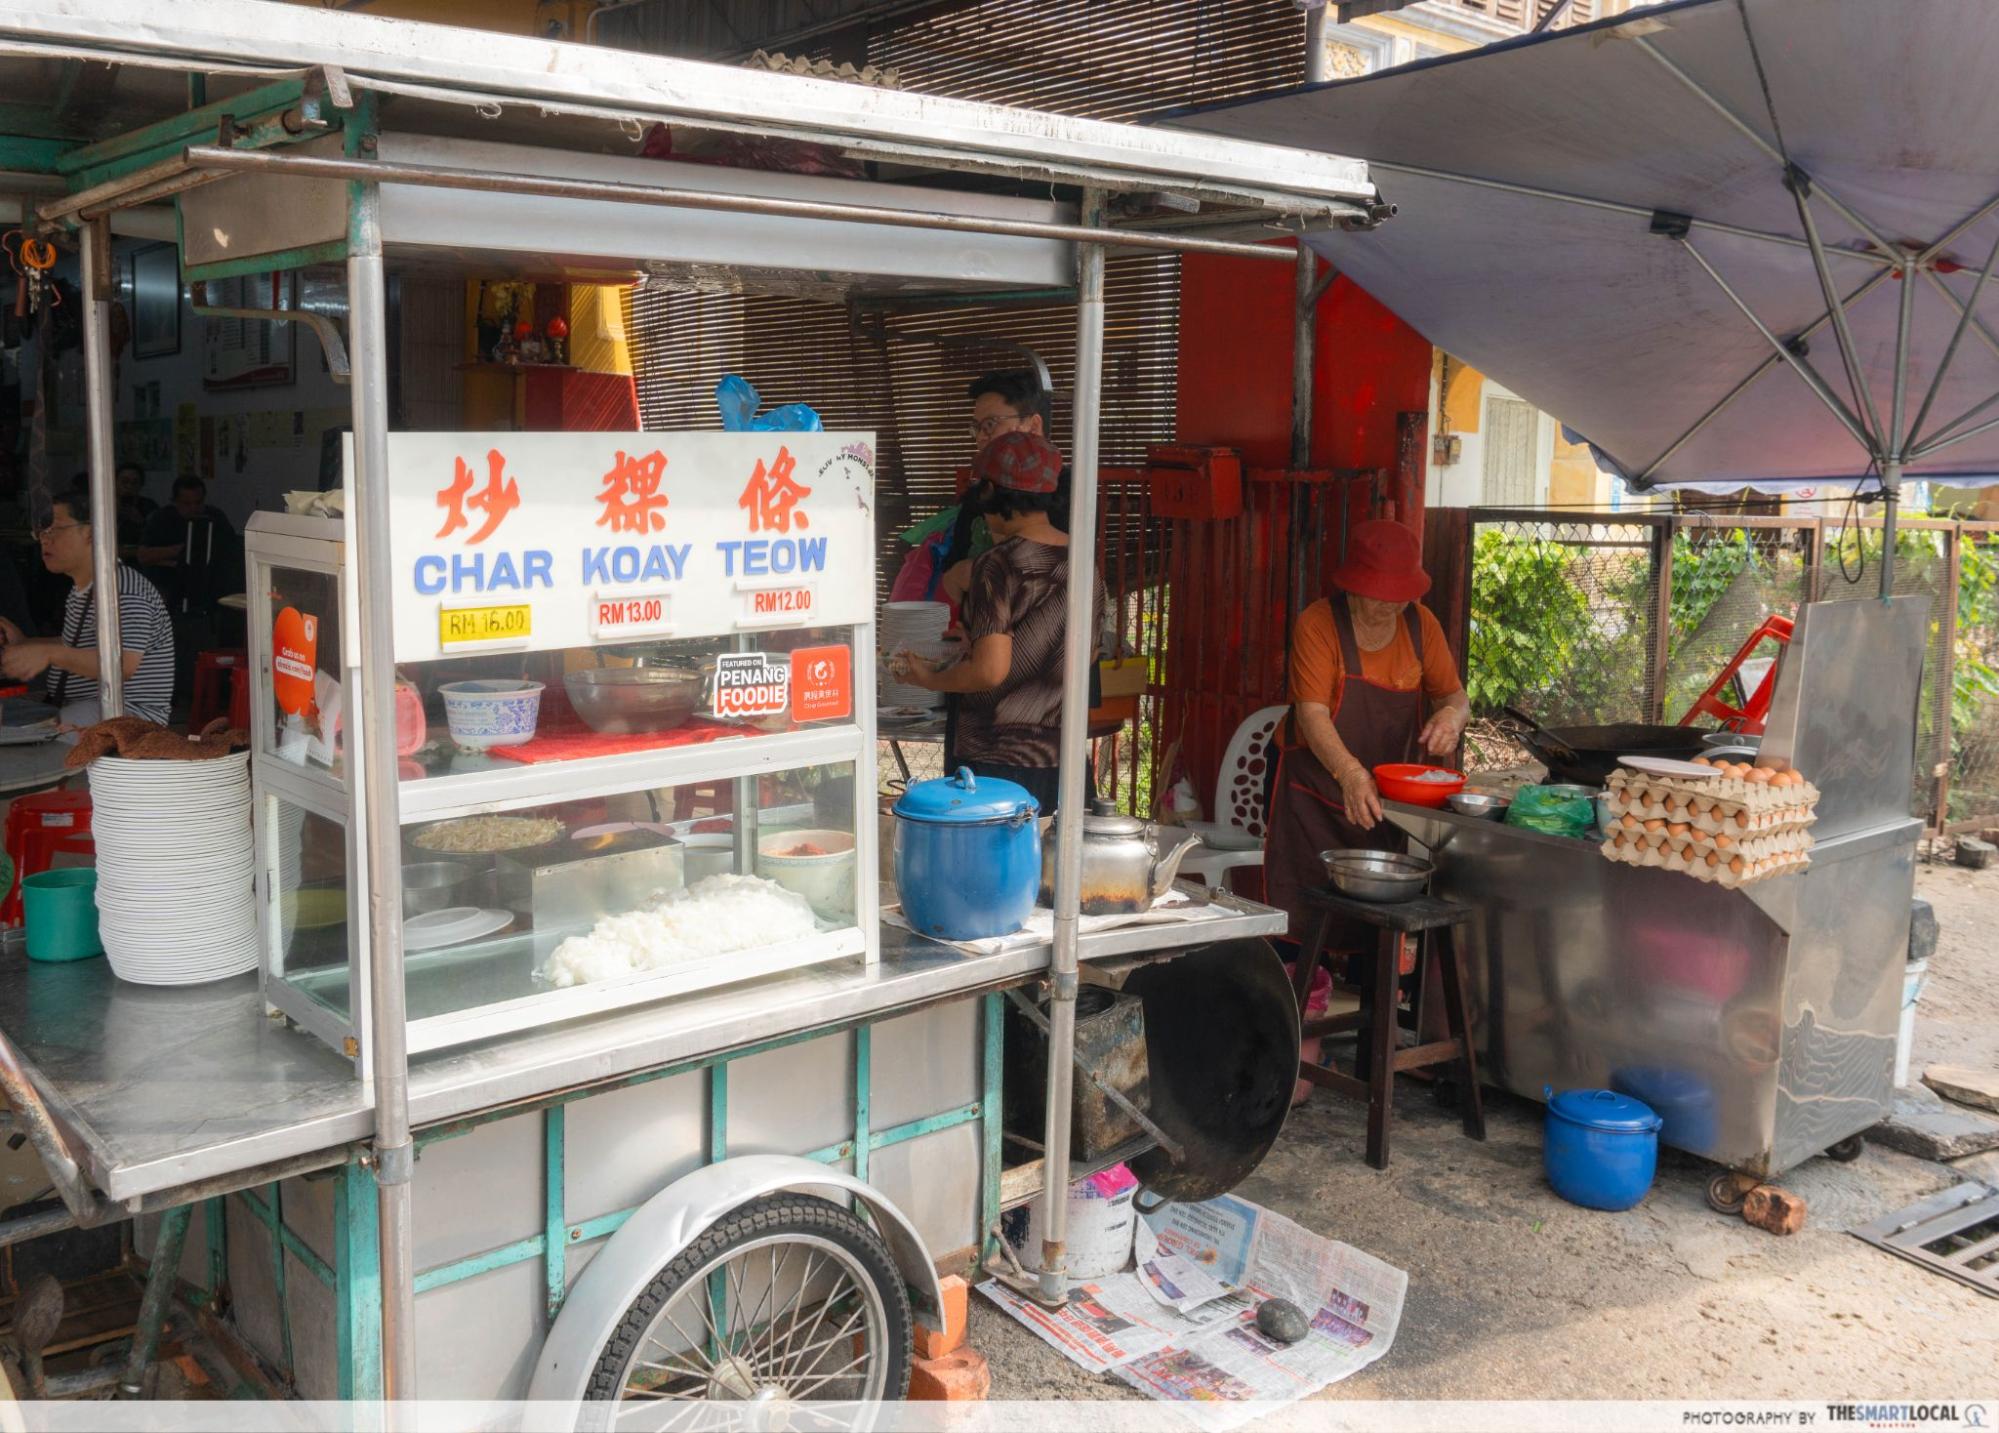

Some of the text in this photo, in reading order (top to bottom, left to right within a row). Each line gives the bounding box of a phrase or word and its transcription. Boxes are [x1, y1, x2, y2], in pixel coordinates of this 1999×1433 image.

[414, 537, 828, 595] CHAR KOAY TEOW
[450, 609, 525, 635] RM 16.00
[722, 660, 752, 668] FEATURED
[721, 667, 785, 686] PENANG
[721, 685, 785, 707] FOODIE
